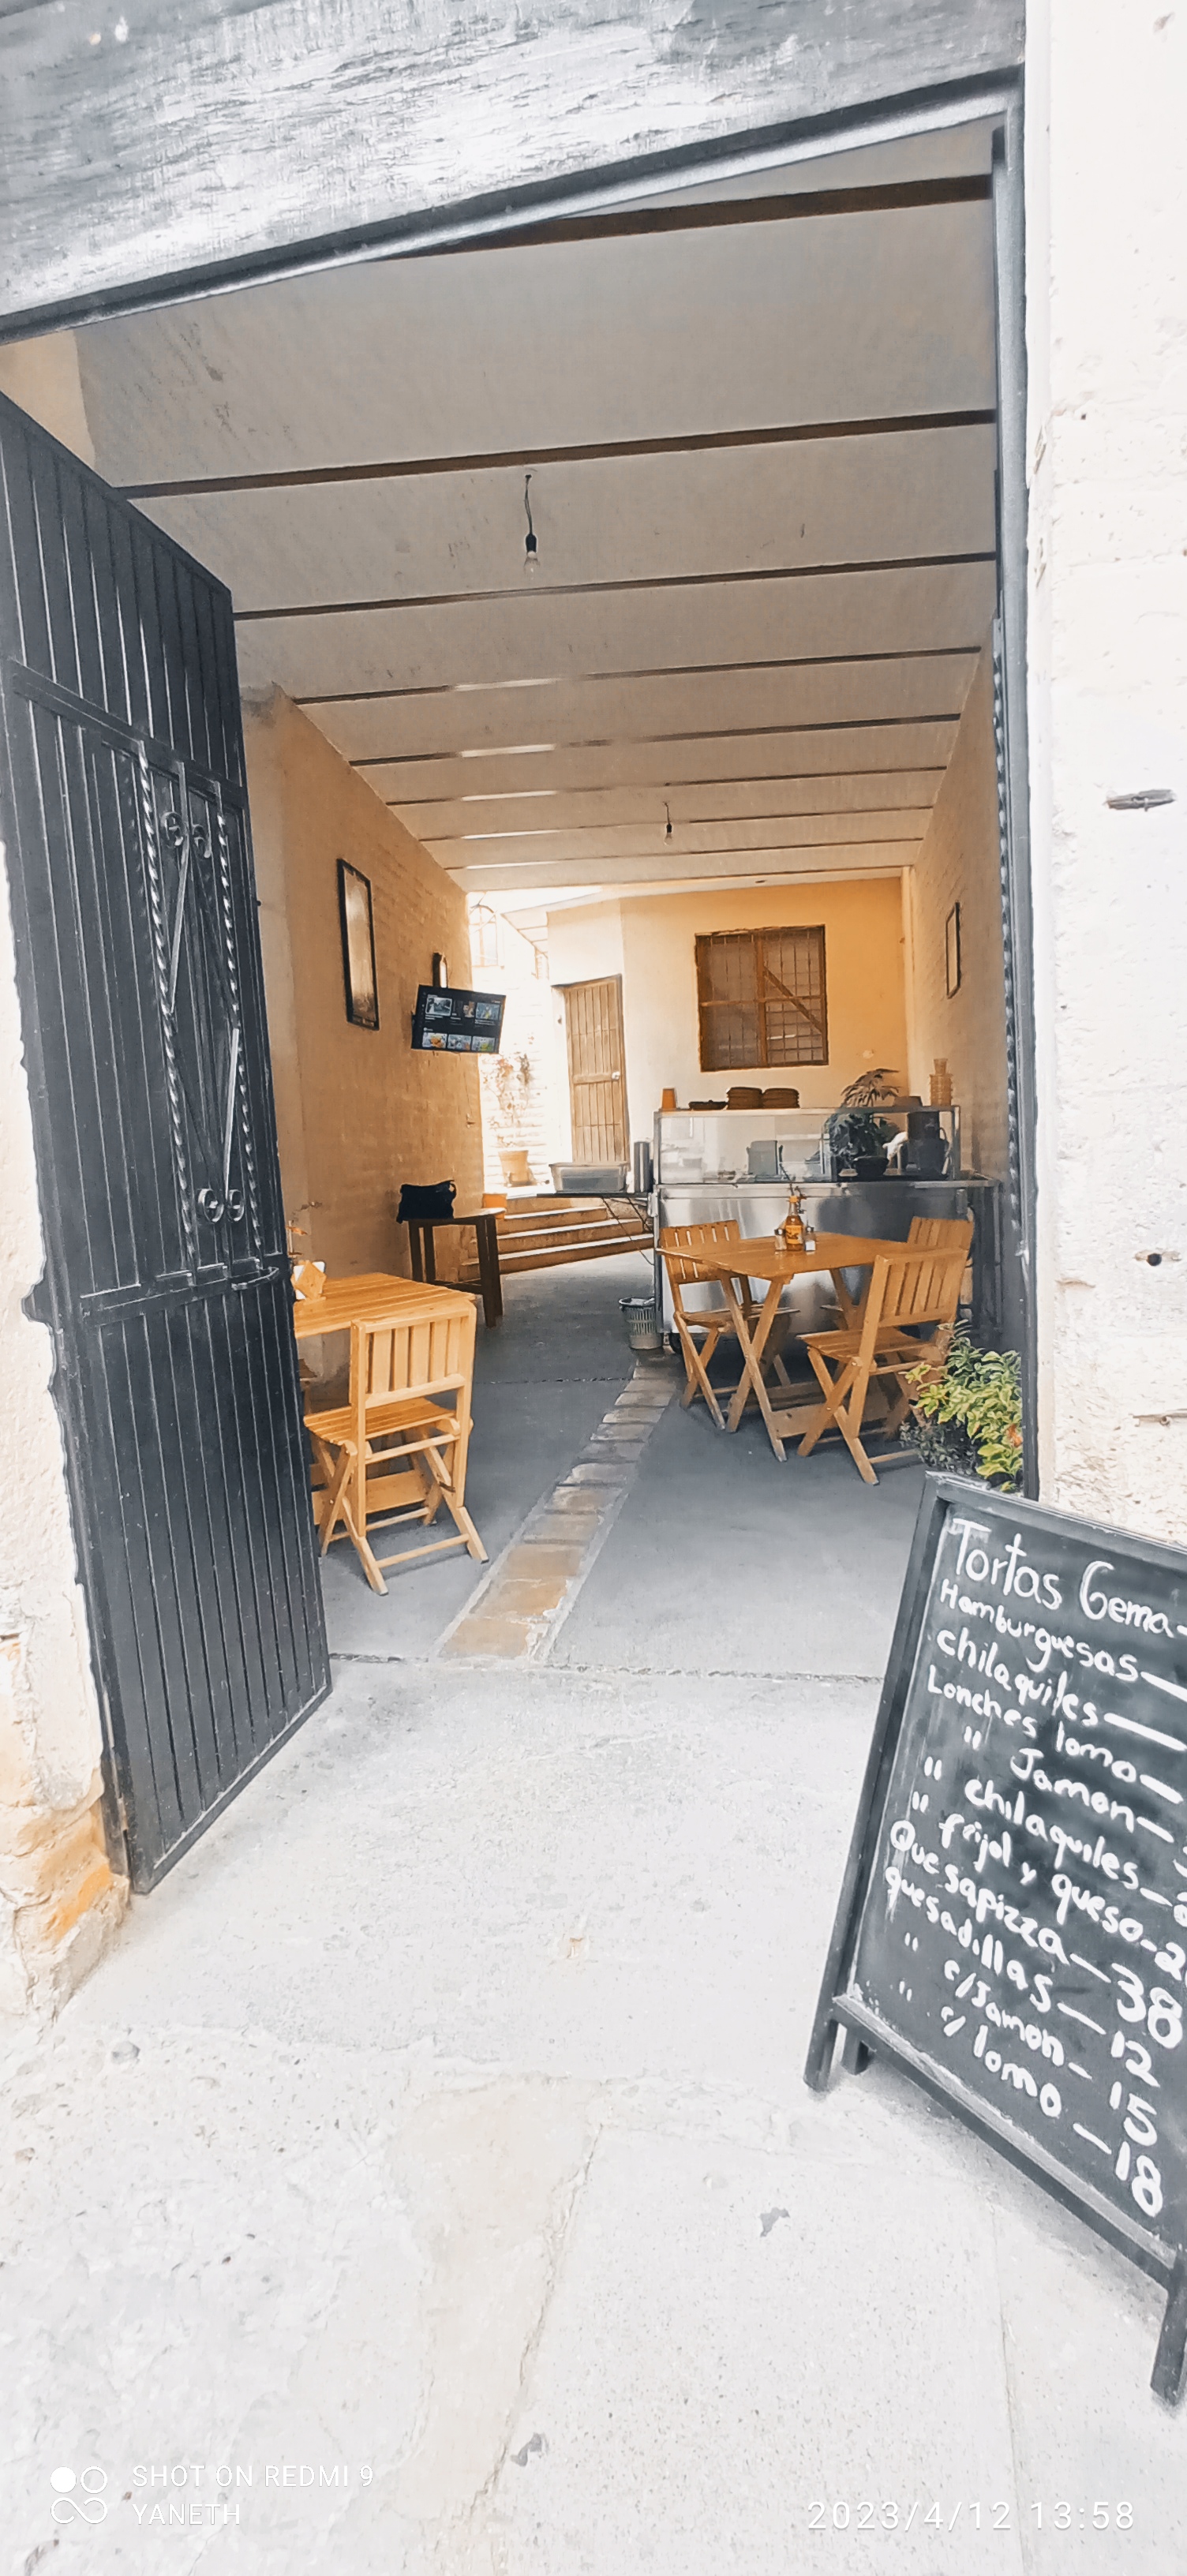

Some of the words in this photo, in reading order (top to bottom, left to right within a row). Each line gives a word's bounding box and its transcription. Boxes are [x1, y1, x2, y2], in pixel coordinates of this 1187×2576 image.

[953, 1518, 1062, 1610] Tortas
[941, 1578, 1138, 1682] Hamburguesas
[928, 1664, 1037, 1738] Lonches
[1052, 1874, 1144, 1942] queso
[1112, 1964, 1182, 2049] 38
[1111, 2031, 1161, 2087] 12
[1110, 2082, 1157, 2146] 15
[1116, 2141, 1163, 2217] 18
